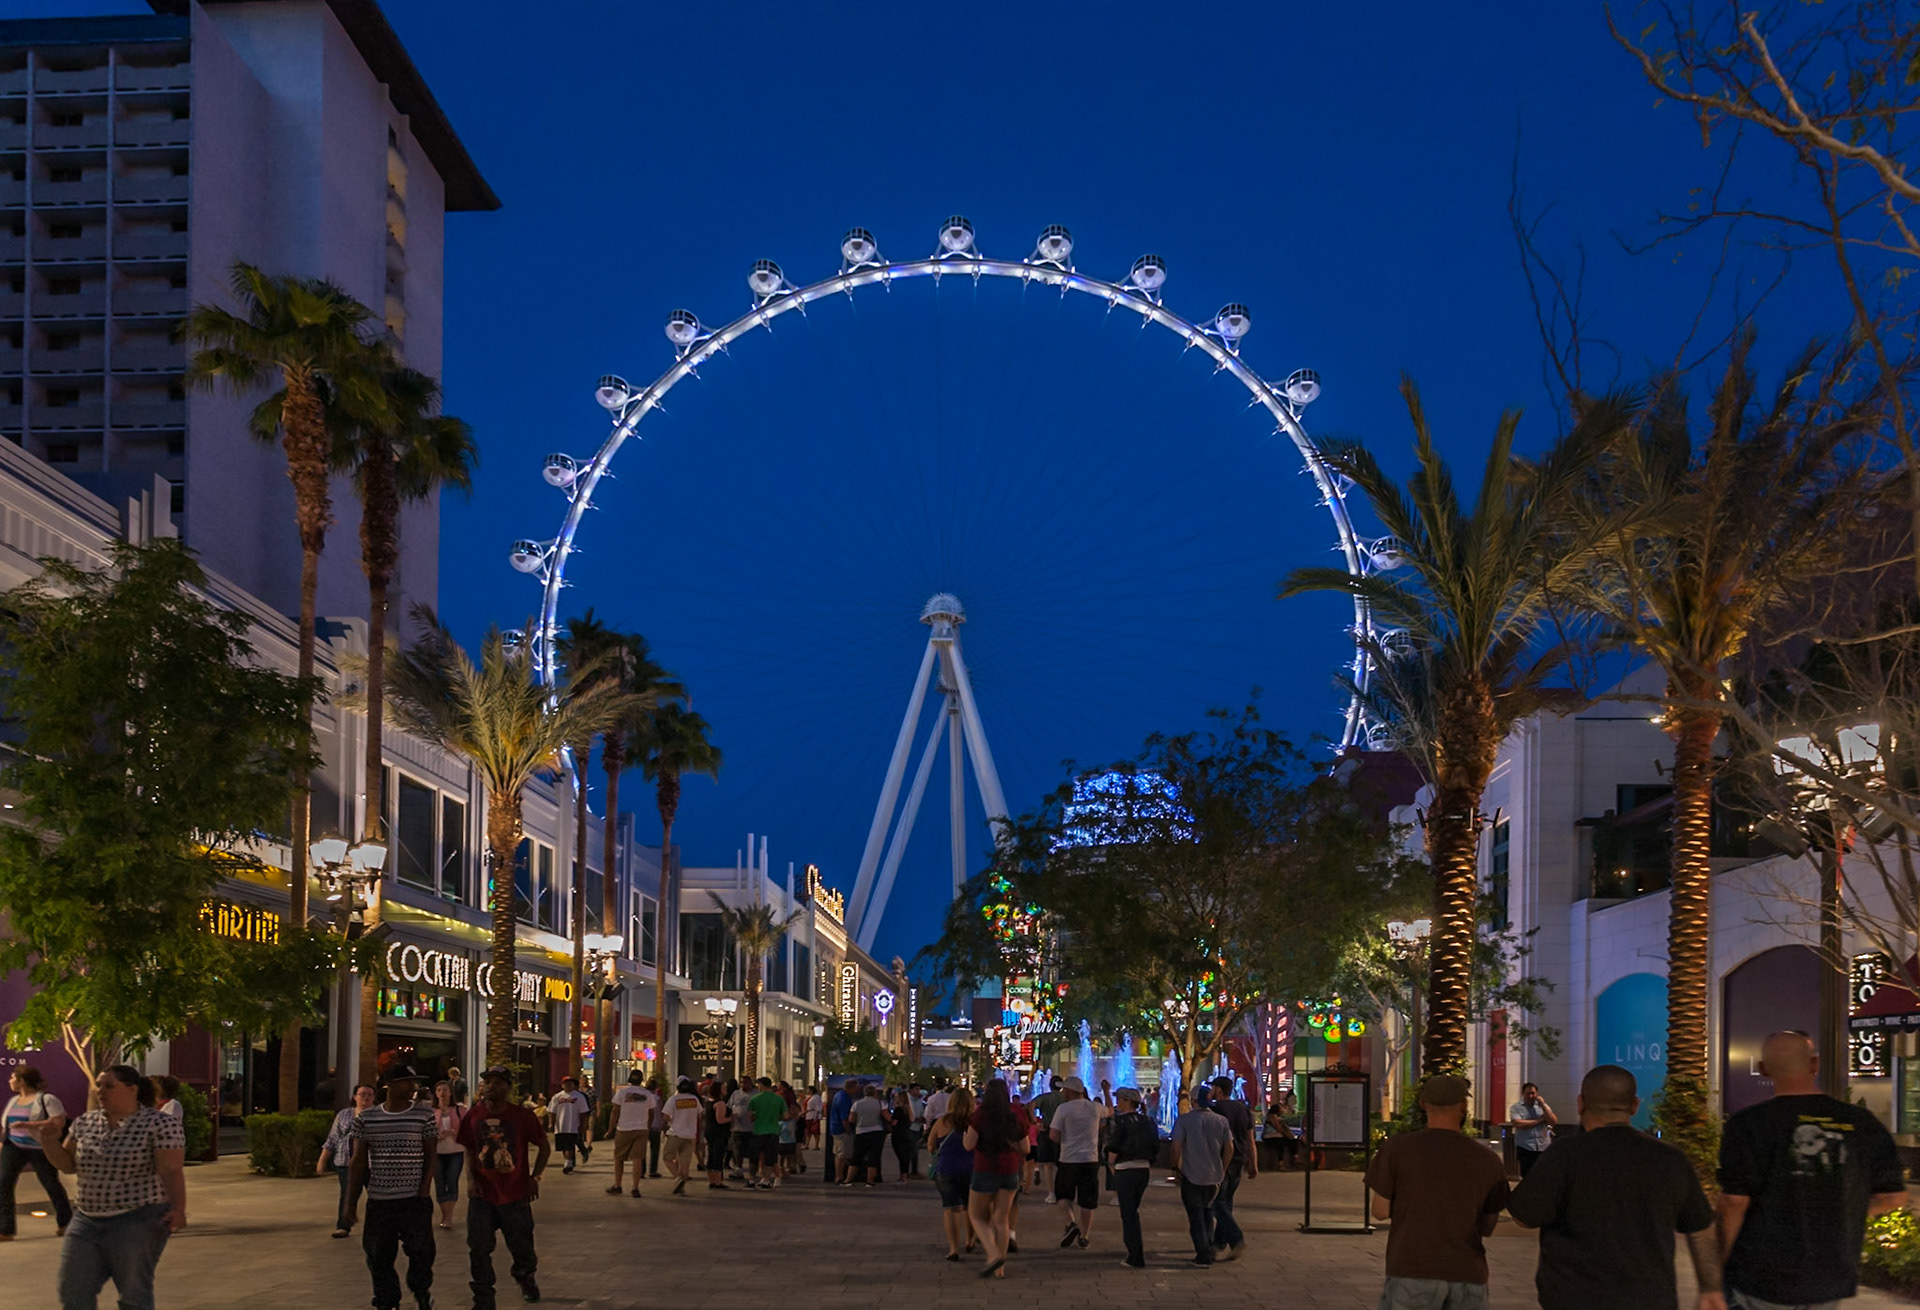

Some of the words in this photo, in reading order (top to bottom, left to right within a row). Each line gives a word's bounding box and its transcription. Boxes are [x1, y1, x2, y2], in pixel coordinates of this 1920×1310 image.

[386, 941, 471, 991] COCKTAIL
[476, 962, 542, 1003] COPANY
[842, 966, 855, 1030] Ghirardel
[693, 1037, 734, 1048] BROOKYN
[1615, 1042, 1661, 1062] LINQ
